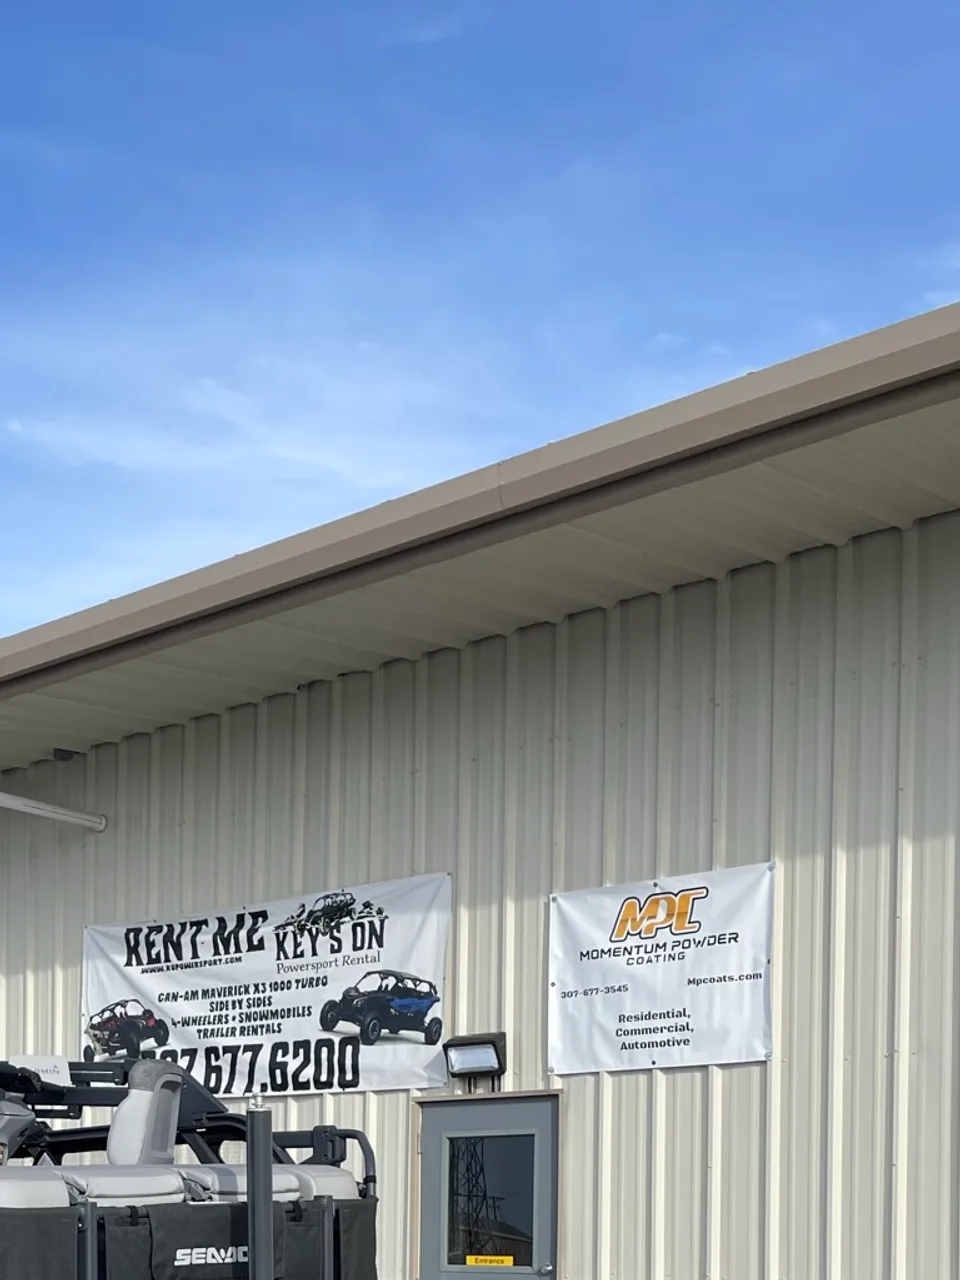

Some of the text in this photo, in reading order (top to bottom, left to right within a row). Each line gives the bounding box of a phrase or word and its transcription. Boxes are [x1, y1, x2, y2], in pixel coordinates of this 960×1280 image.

[609, 887, 709, 943] MPC
[124, 910, 269, 967] RENT ME
[351, 918, 387, 952] ON
[579, 932, 740, 961] MOMENTUM POWDER
[276, 951, 381, 975] Powersport Rental
[626, 952, 686, 966] COATING
[687, 972, 763, 987] Mpcoats.com
[157, 975, 329, 1003] CAN-AM MAVERICK X3 1000 TURBO
[560, 984, 629, 999] 307-677-3545
[209, 995, 273, 1013] SIDE BY SIDES
[170, 1005, 313, 1028] 4-WHEELERS SNOWMOBILES
[618, 1008, 692, 1024] Residential,
[196, 1023, 282, 1040] TRAILER RENTALS
[615, 1022, 695, 1038] Commercial,
[619, 1037, 691, 1051] Automotive
